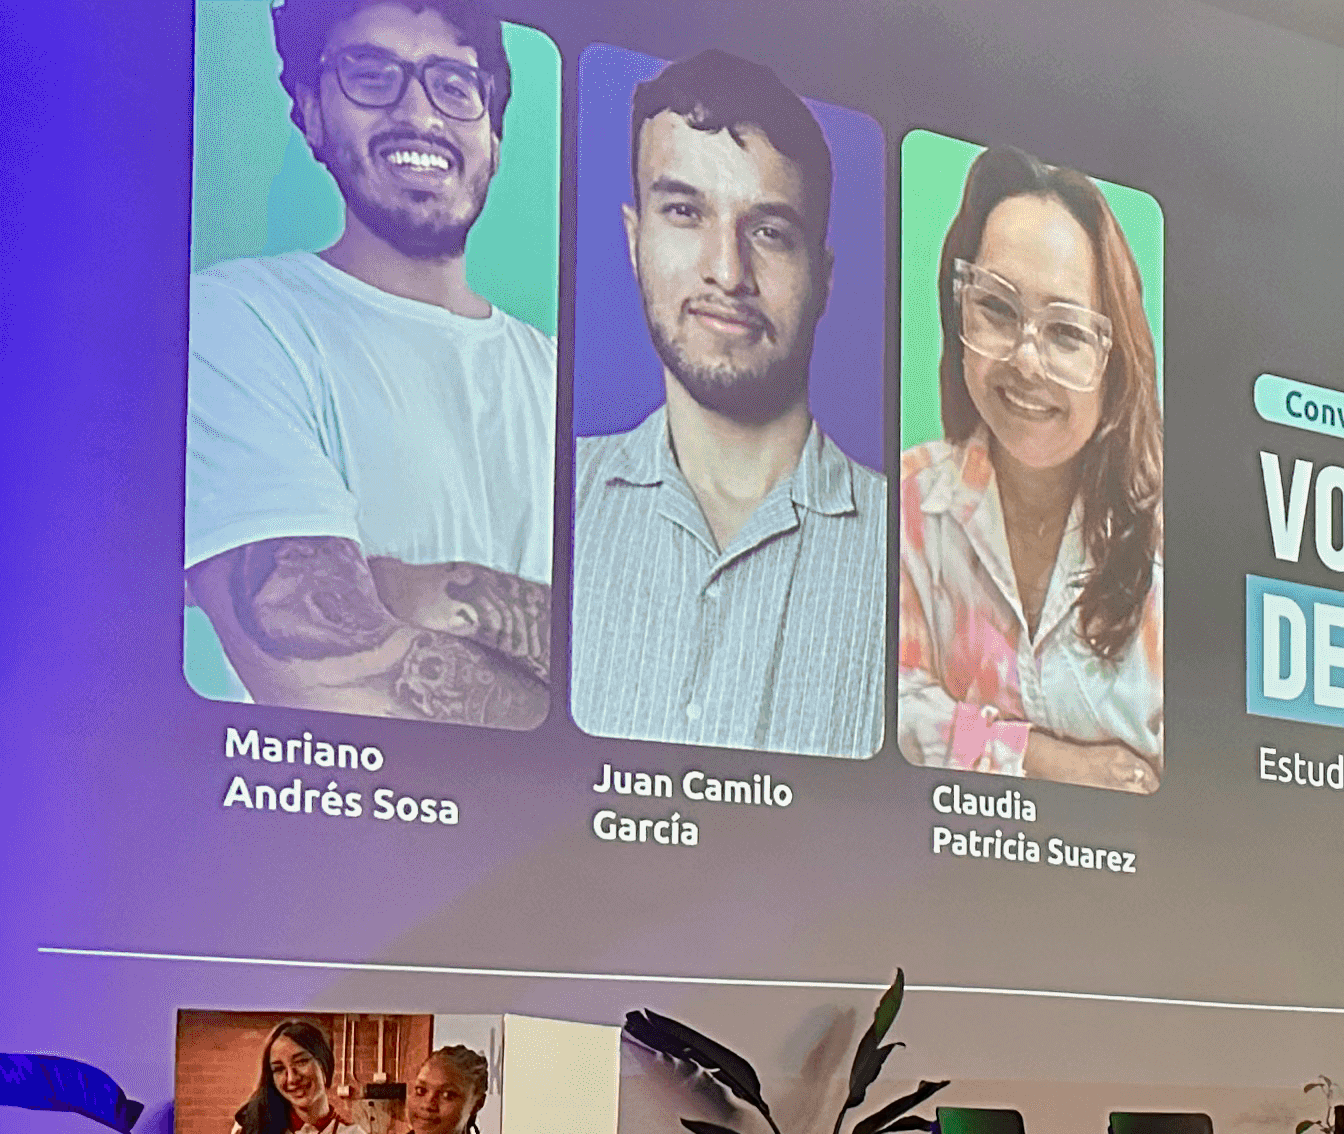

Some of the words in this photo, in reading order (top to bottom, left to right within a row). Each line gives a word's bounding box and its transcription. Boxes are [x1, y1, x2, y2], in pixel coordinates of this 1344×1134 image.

[224, 727, 385, 773] Mariano
[223, 776, 364, 819] Andrés
[373, 787, 460, 827] Sosa
[592, 763, 673, 800] Juan
[683, 768, 794, 809] Camilo
[932, 785, 1038, 824] Claudia
[592, 809, 699, 847] García
[932, 827, 1041, 865] Patricia
[1047, 837, 1137, 876] Suarez
